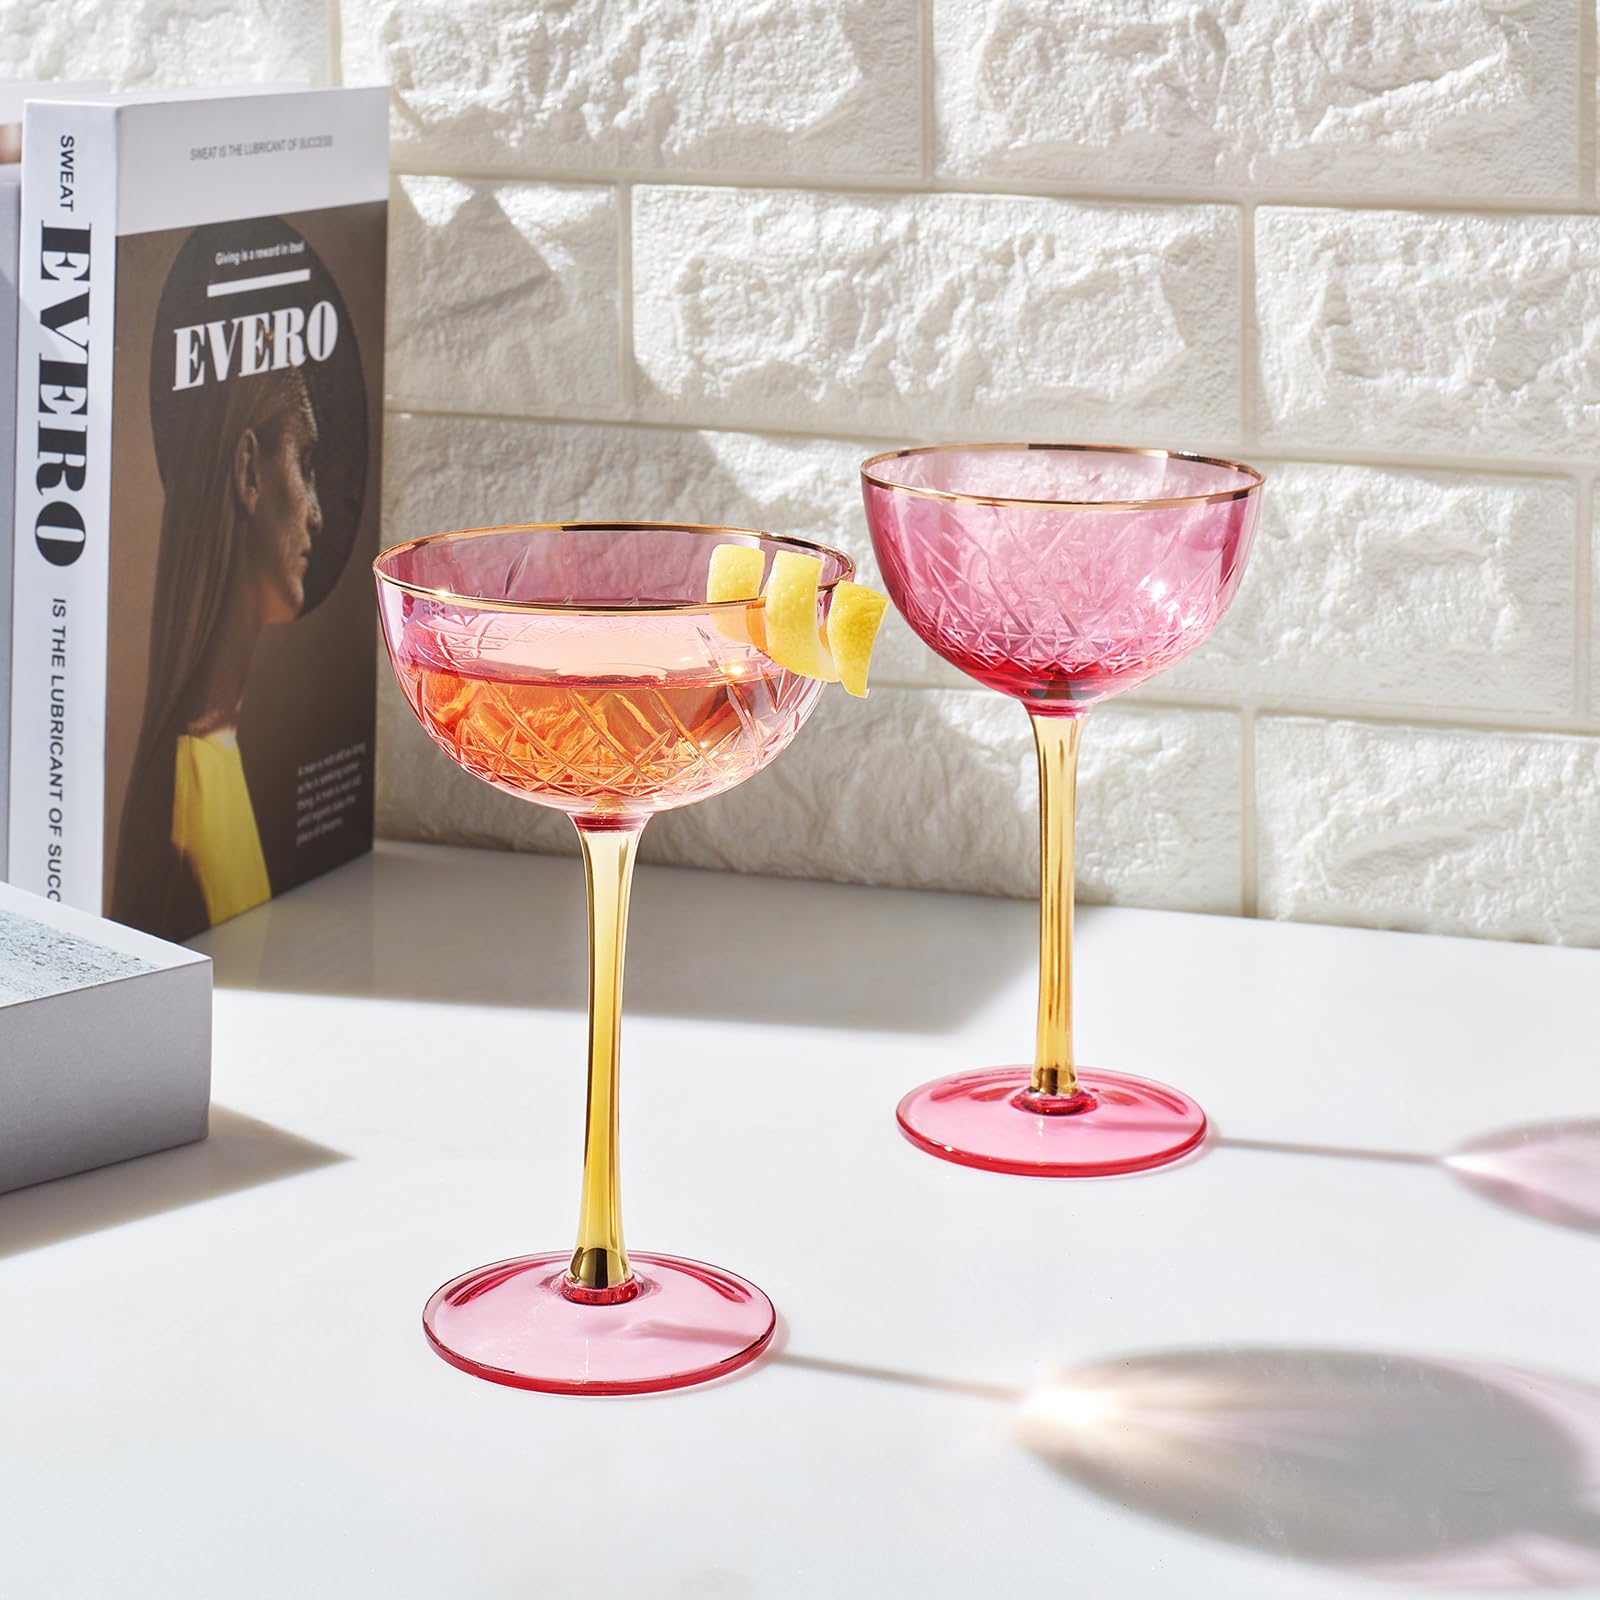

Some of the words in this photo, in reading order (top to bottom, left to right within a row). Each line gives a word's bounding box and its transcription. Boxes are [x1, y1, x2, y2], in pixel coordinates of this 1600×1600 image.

[190, 145, 217, 161] SWEAT
[218, 145, 226, 158] IS
[228, 143, 243, 156] THE
[244, 138, 286, 155] LUBRICANT
[287, 137, 297, 151] OF
[60, 135, 75, 211] SWEAT
[214, 250, 240, 266] Giving
[255, 243, 280, 259] reward
[172, 299, 338, 391] EVERO
[34, 219, 93, 567] EVERO
[52, 597, 67, 618] IS
[51, 625, 66, 668] THE
[49, 674, 65, 802] LUBRICANT
[48, 807, 63, 838] OF
